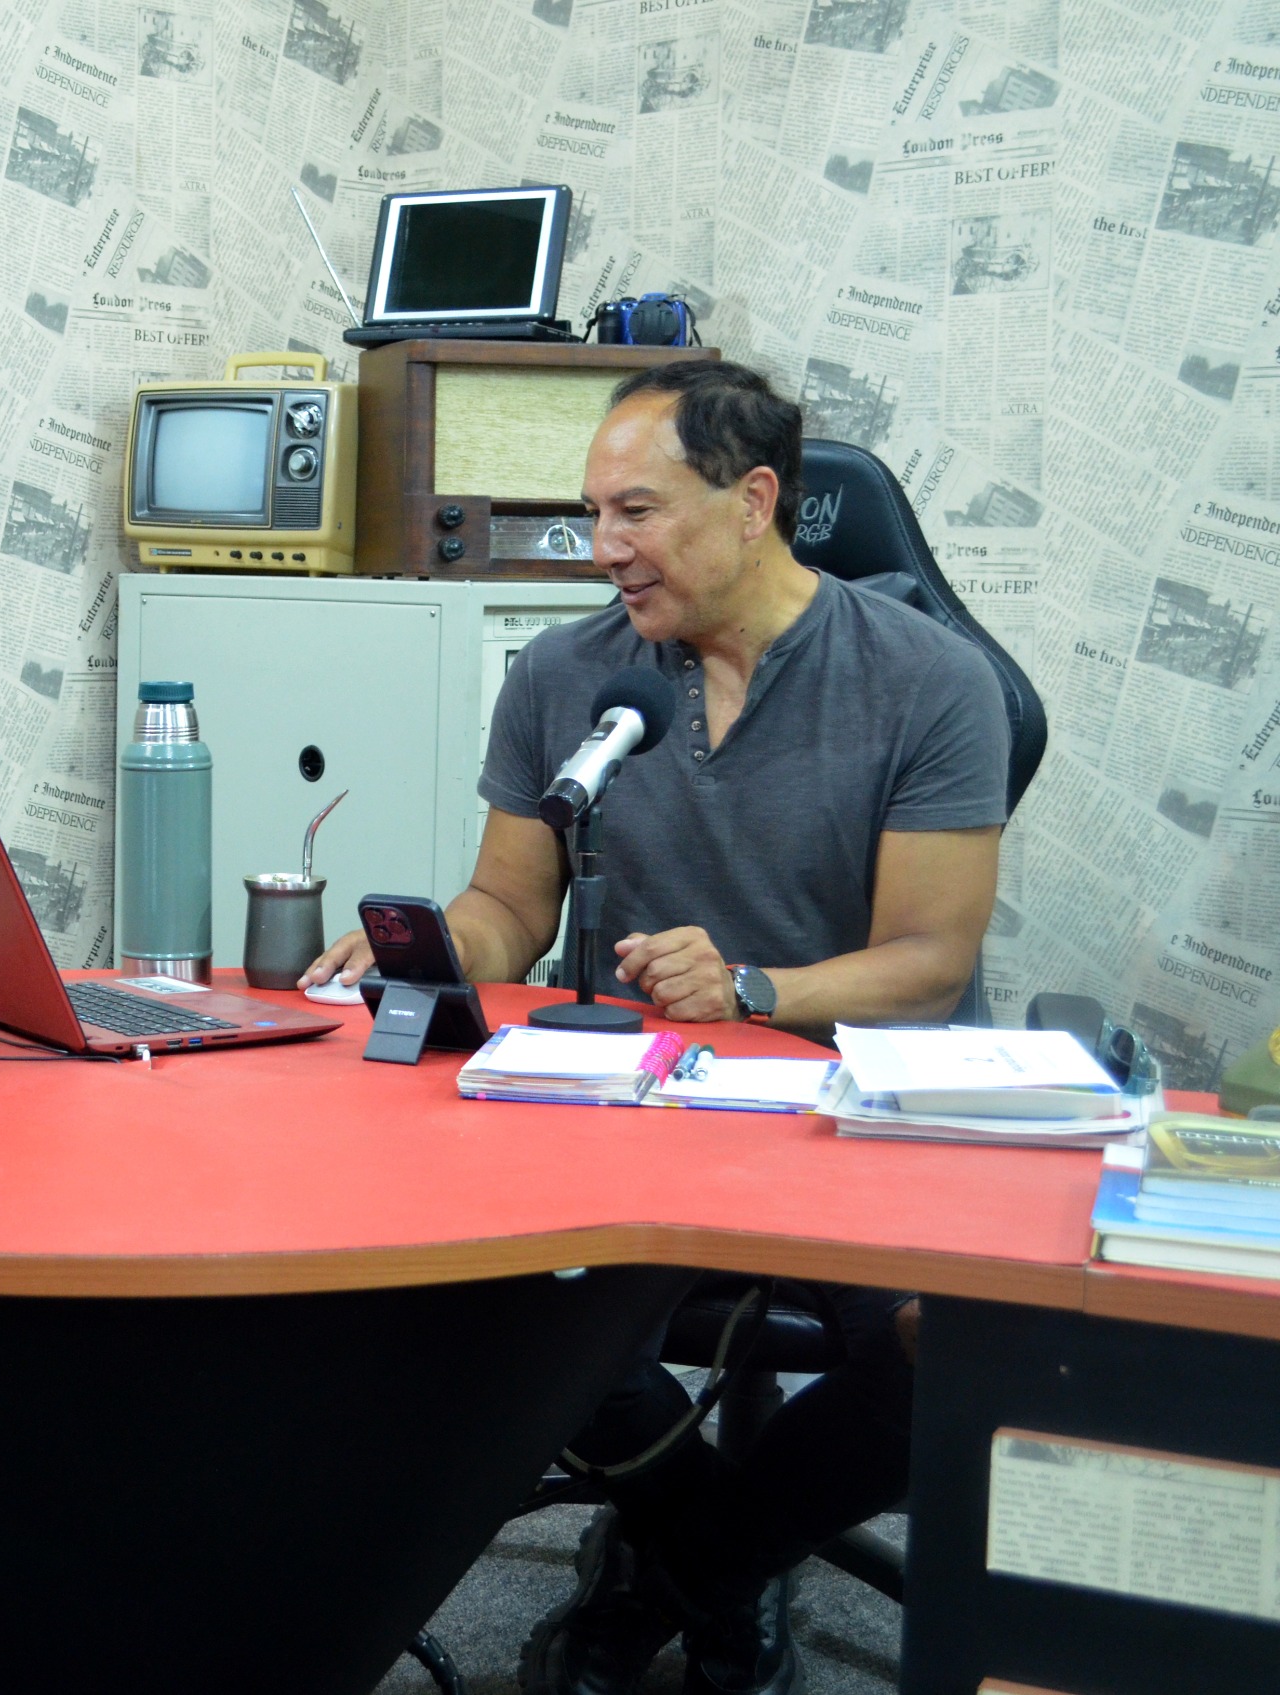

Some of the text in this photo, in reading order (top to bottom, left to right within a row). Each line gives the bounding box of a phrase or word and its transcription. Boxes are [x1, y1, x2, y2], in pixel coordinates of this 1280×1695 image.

[242, 36, 258, 52] the
[753, 35, 774, 52] the
[53, 44, 118, 86] Independence
[1226, 57, 1280, 81] Indepen
[922, 35, 970, 121] RESOURCES
[555, 112, 616, 135] Independence
[954, 167, 993, 186] BEST
[1093, 216, 1116, 234] the
[108, 209, 145, 279] RESOURCES
[847, 285, 923, 316] Independence
[134, 328, 164, 345] BEST
[48, 418, 112, 453] Independence
[801, 483, 844, 526] ON
[793, 523, 833, 546] RGB
[948, 579, 978, 594] EST
[1074, 640, 1096, 659] the
[40, 781, 107, 811] Independence
[1183, 934, 1273, 981] Independence
